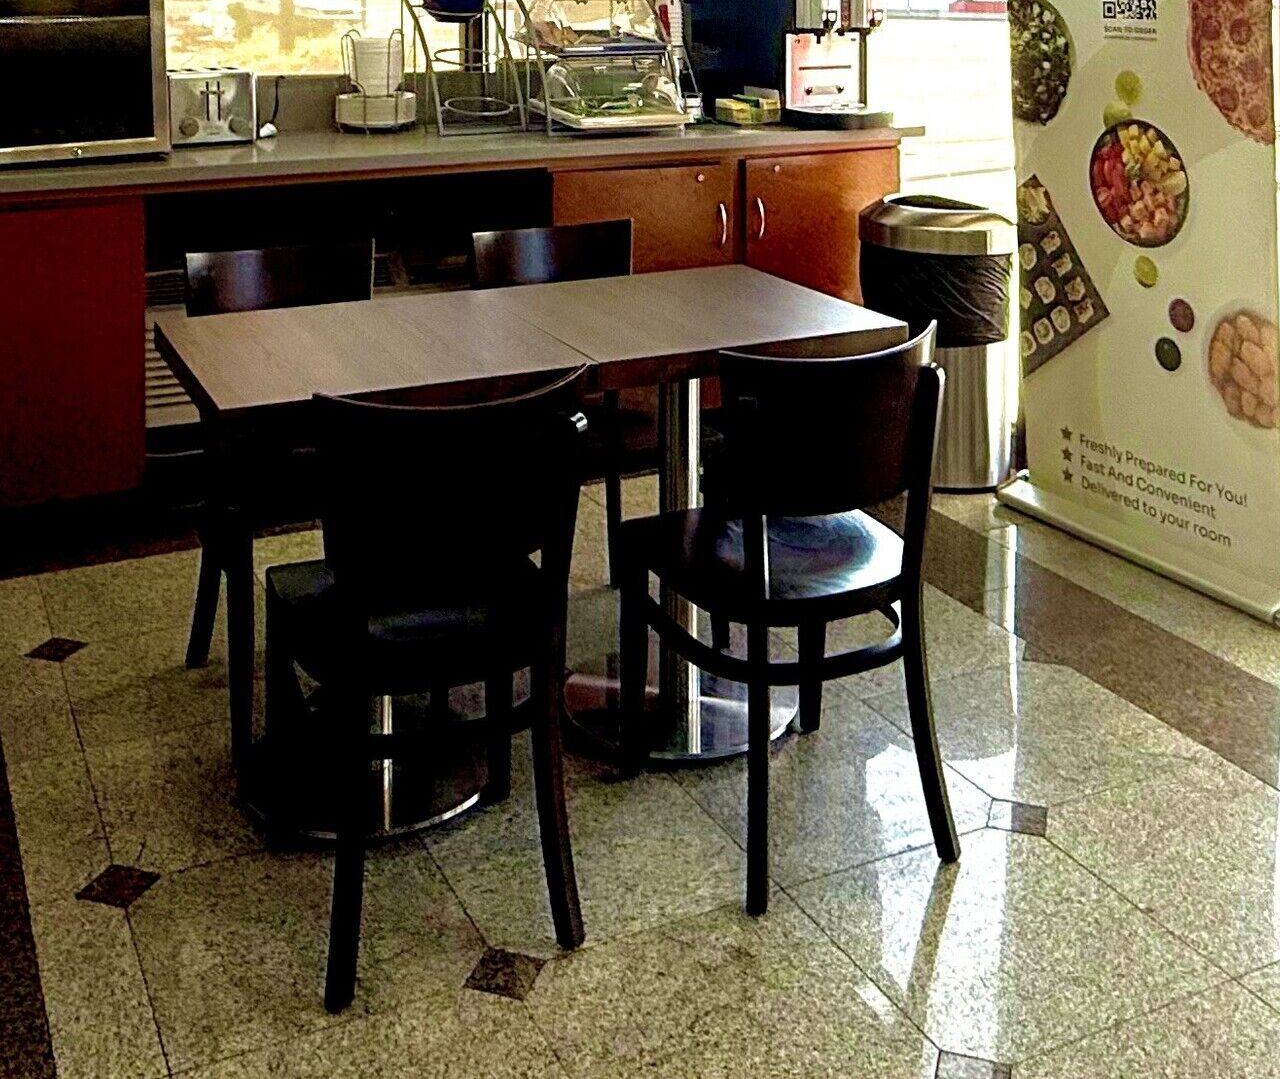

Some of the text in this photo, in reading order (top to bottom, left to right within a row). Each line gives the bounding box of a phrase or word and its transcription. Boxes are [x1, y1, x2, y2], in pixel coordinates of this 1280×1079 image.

[1079, 433, 1248, 508] Freshly Prepared For You!
[1080, 455, 1216, 520] Fast And Convenient
[1081, 475, 1232, 548] Delivered to your room
